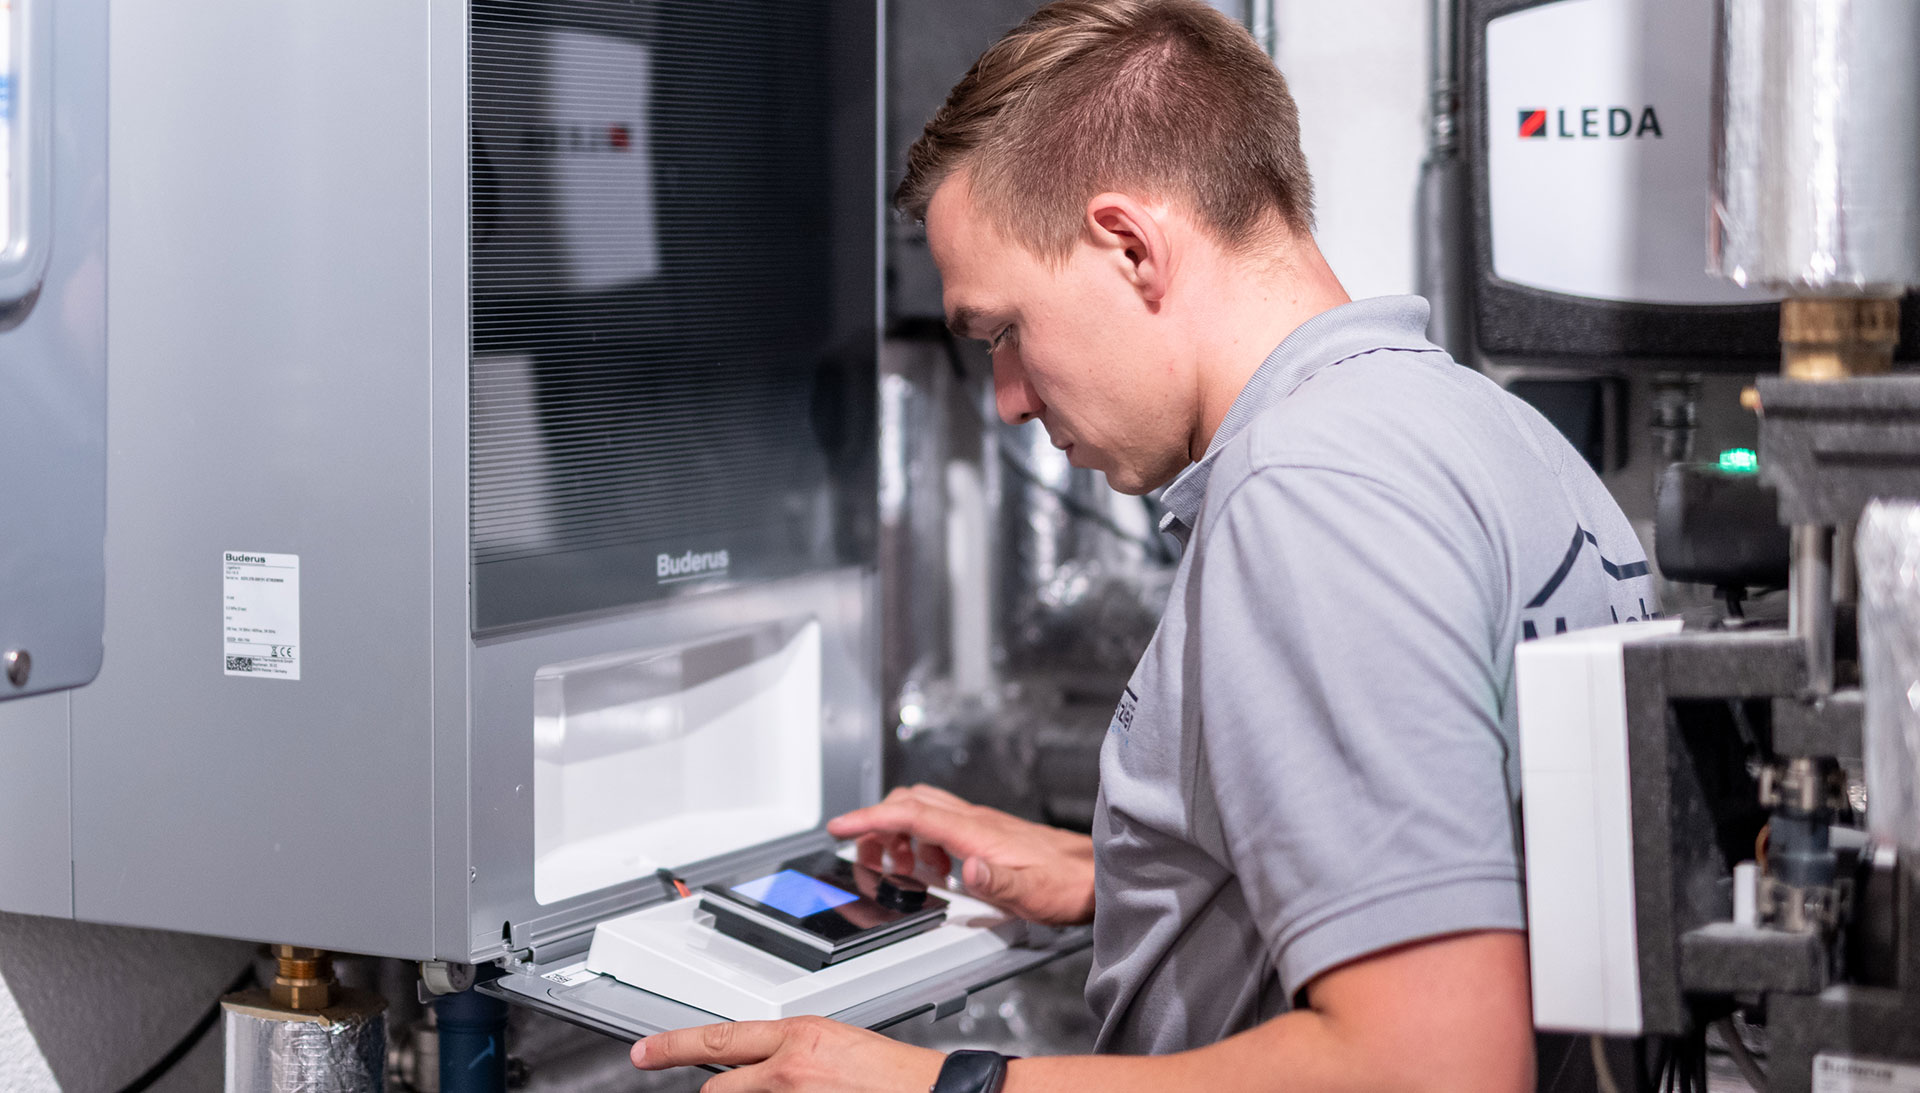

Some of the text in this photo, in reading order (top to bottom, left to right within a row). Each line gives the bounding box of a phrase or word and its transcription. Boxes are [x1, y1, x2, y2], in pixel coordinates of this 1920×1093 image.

[1558, 105, 1663, 138] LEDA
[225, 553, 266, 563] Buderus
[657, 550, 729, 577] Buderus
